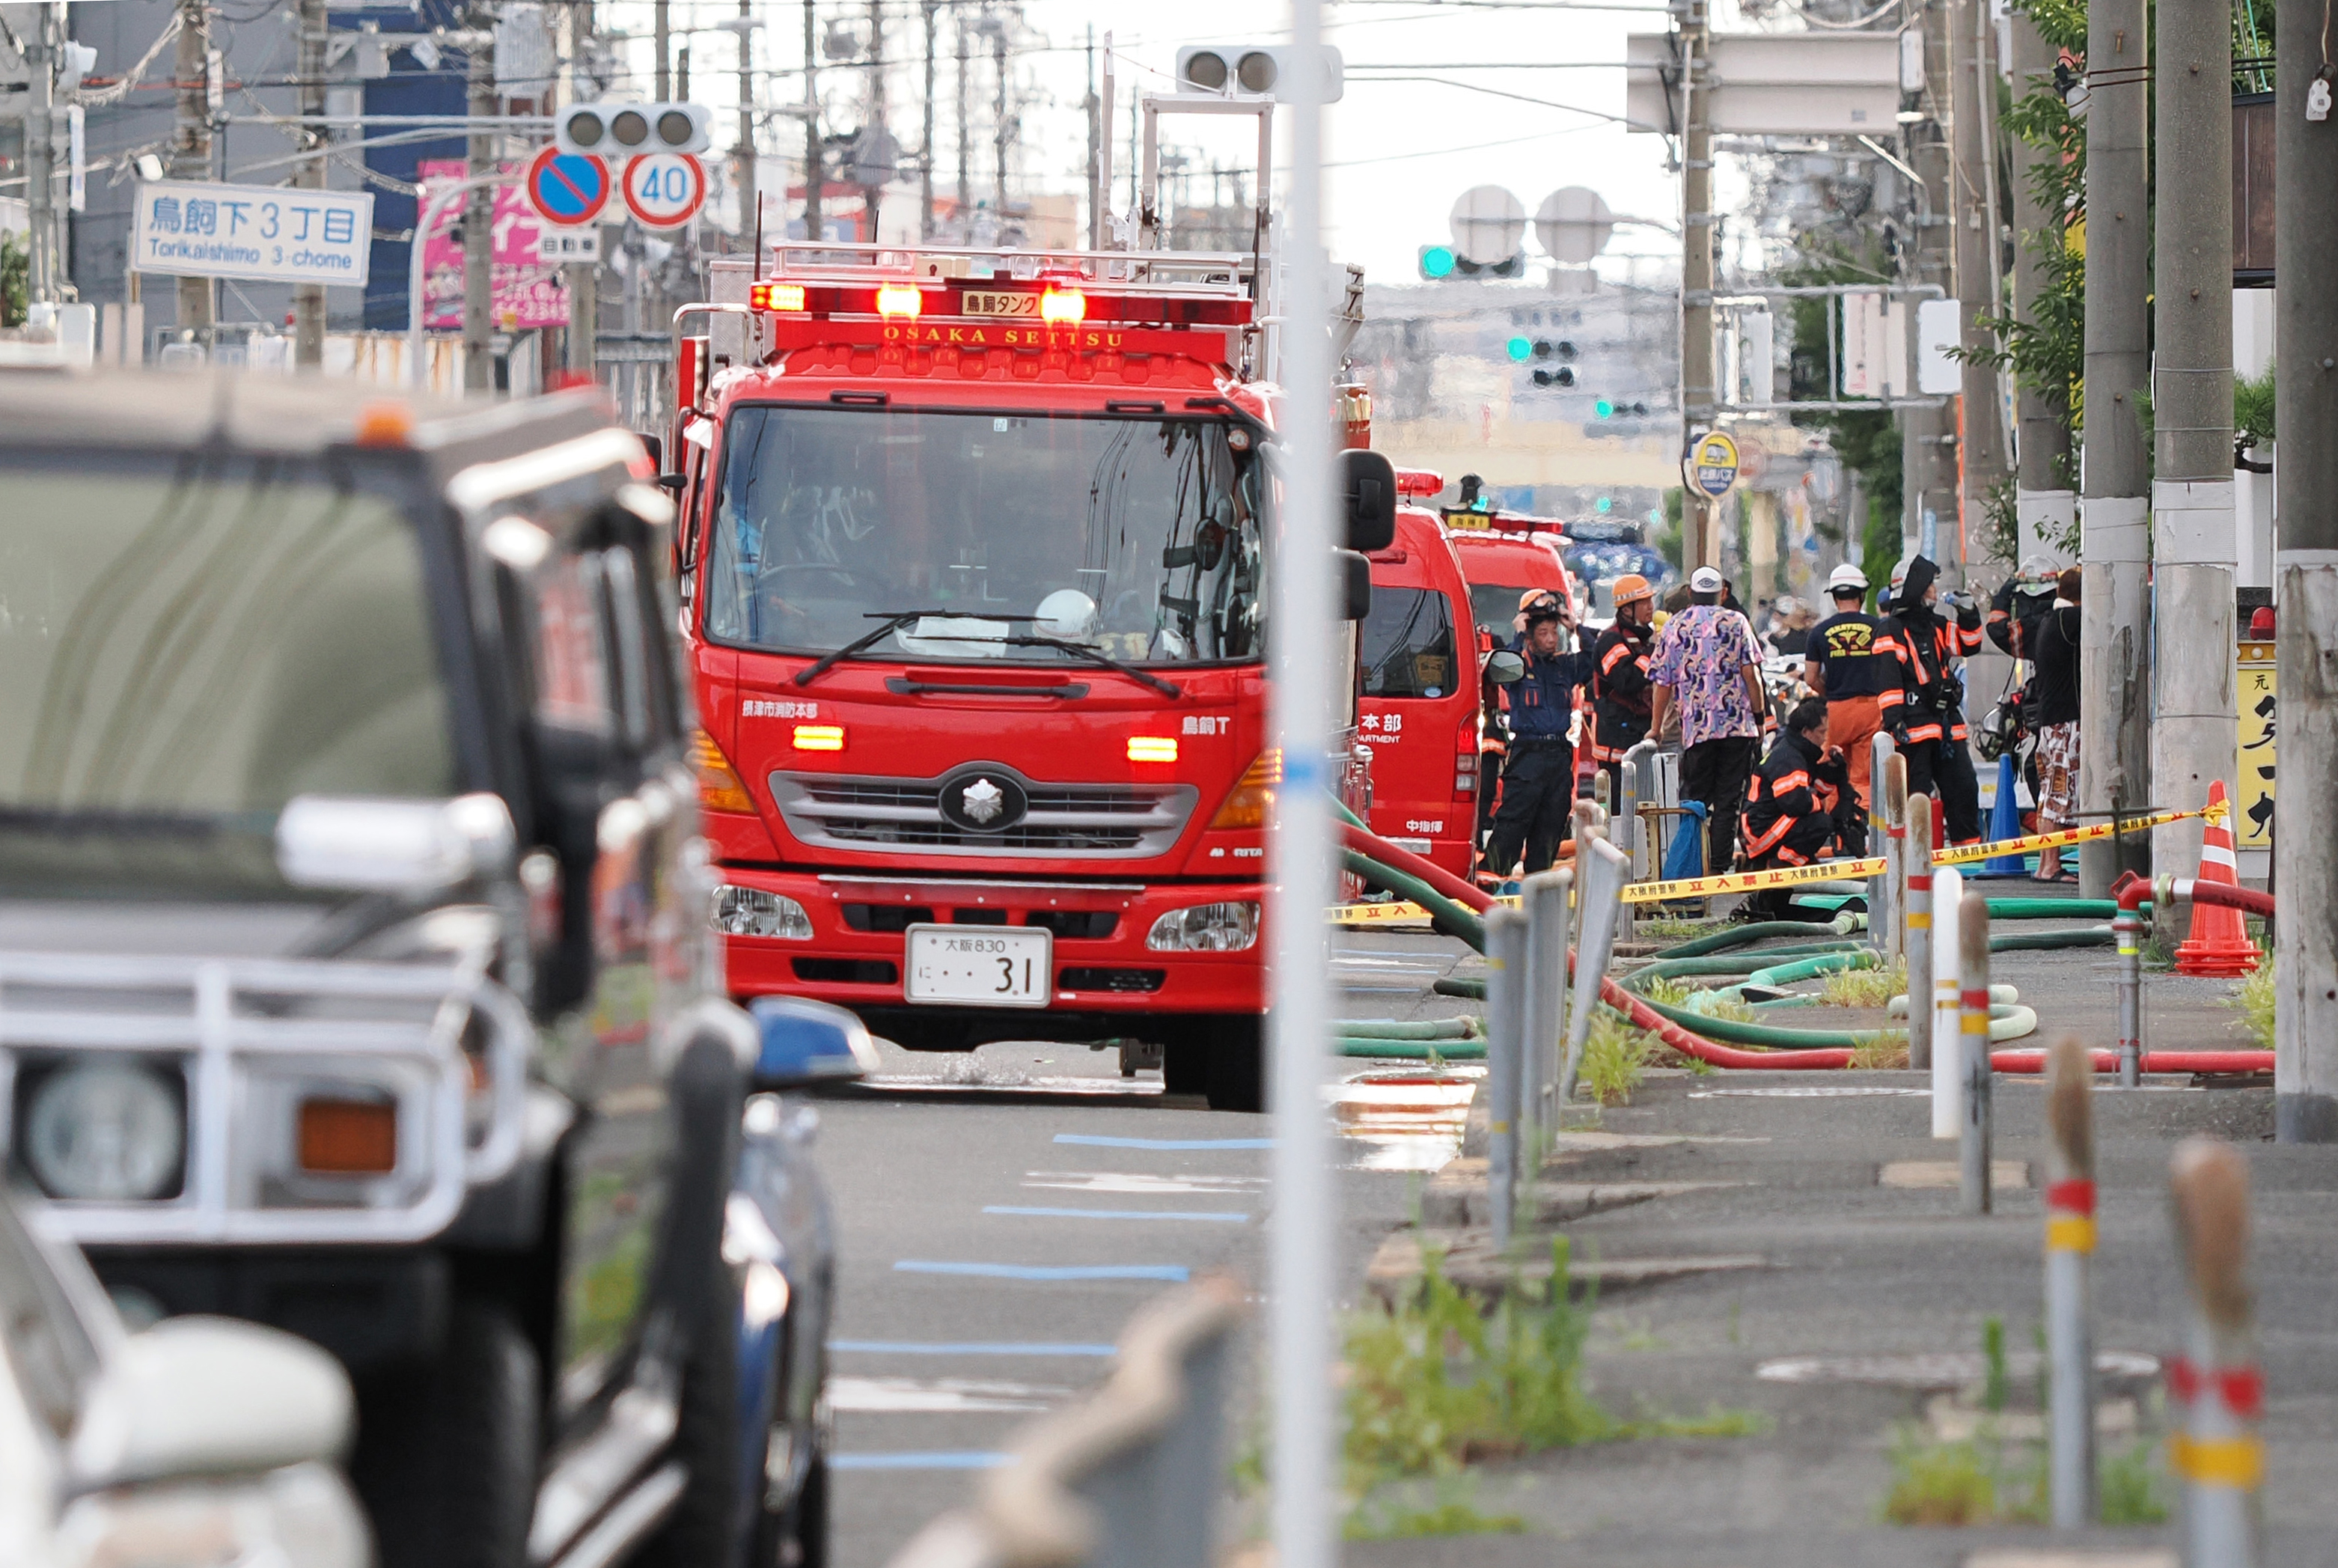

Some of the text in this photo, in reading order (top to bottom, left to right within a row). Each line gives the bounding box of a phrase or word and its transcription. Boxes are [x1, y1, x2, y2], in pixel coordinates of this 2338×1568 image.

[641, 165, 687, 201] 40
[150, 195, 355, 243] 鳥飼下3丁目
[150, 238, 352, 269] Torikaishimo 3-chome
[966, 295, 1037, 315] 鳥飼タンク
[884, 326, 1123, 347] OSAKA SETTSU
[1361, 713, 1402, 732] 本部
[1209, 847, 1263, 857] MRITA
[1629, 883, 1677, 897] 大阪府警察
[1789, 864, 1838, 880] 大阪府警察
